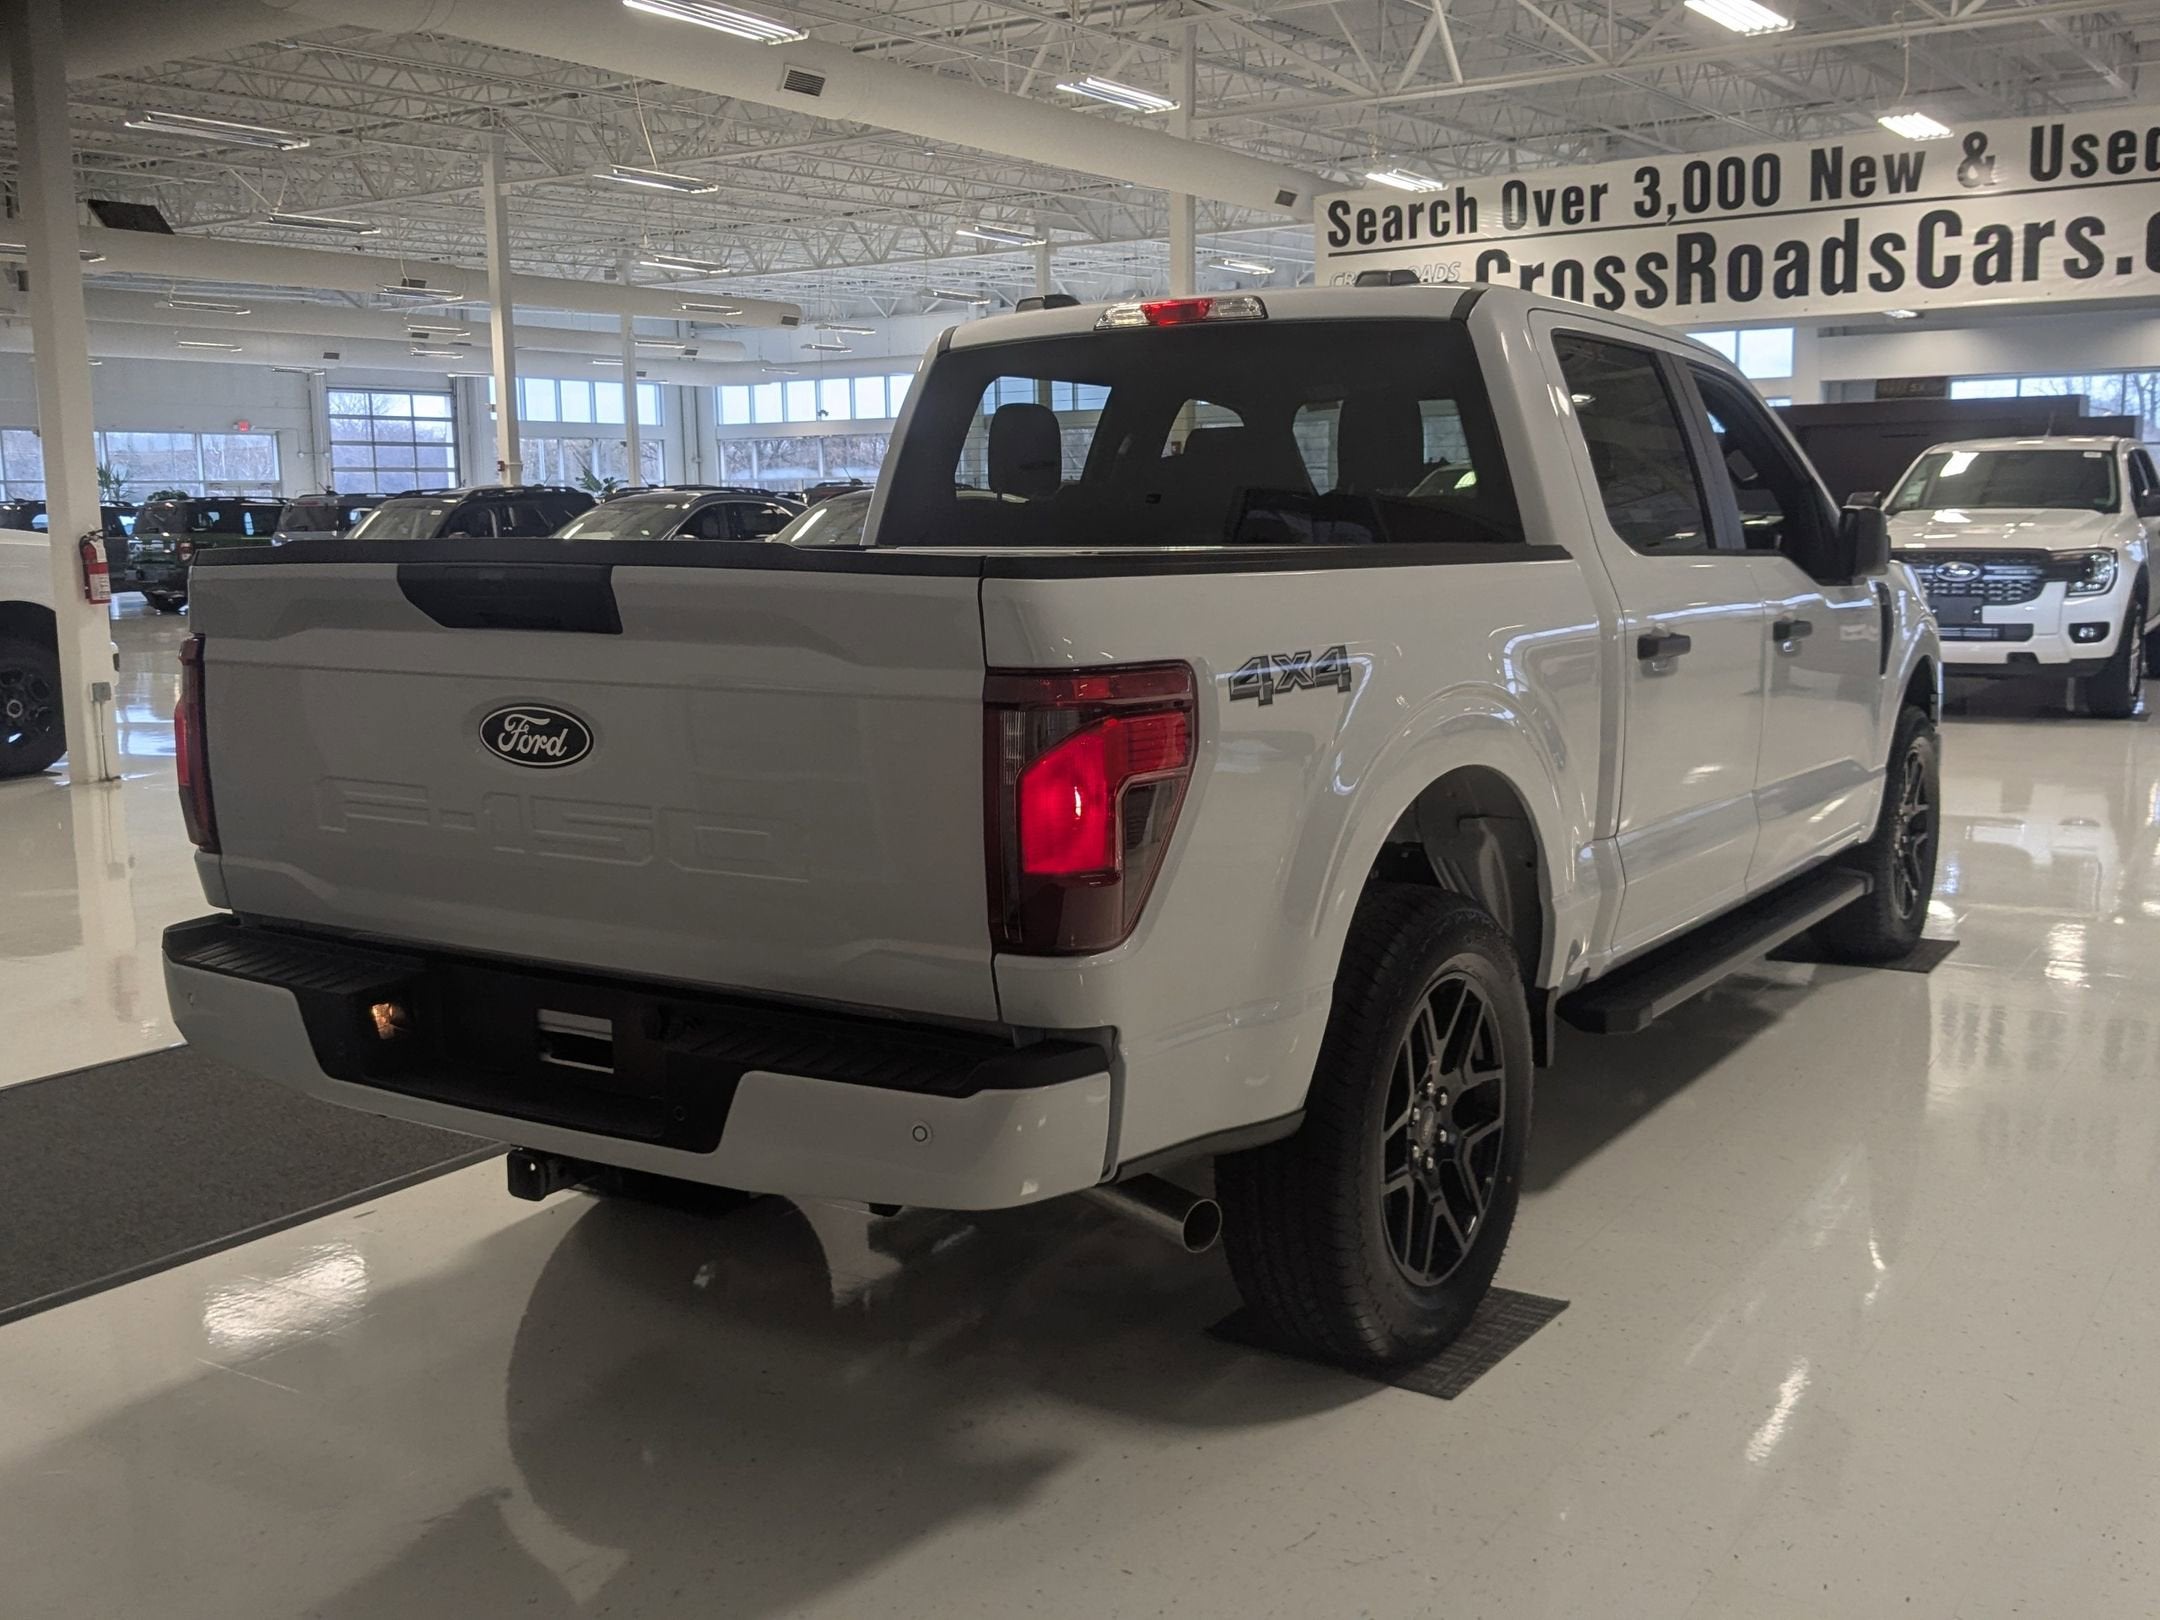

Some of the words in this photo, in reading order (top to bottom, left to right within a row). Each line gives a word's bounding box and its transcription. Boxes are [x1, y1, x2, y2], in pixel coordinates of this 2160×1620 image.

[1328, 186, 1478, 247] Search
[1502, 179, 1609, 231] Over
[1633, 152, 1781, 226] 3,000
[1810, 145, 1926, 201] New
[1957, 131, 1997, 188] &
[497, 713, 569, 757] Ford
